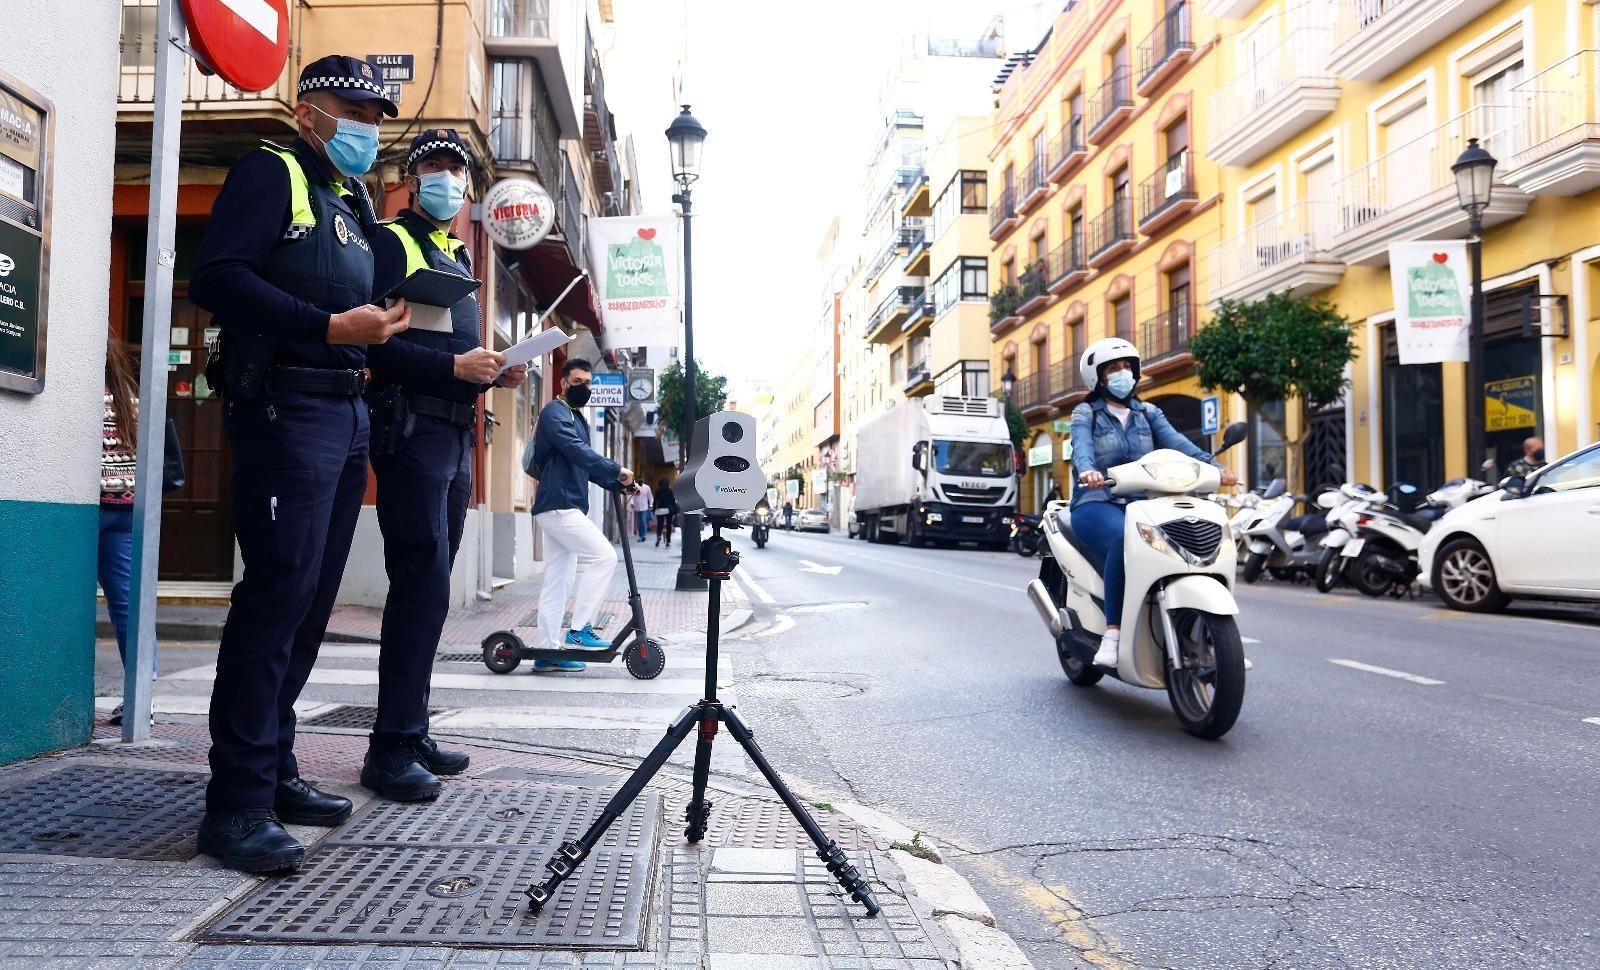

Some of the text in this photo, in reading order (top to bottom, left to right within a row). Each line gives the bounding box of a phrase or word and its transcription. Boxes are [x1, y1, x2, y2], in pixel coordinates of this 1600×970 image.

[376, 56, 402, 65] CALLE
[493, 203, 540, 220] VICTORIA
[590, 387, 622, 395] CLINICA
[590, 396, 621, 404] DENTAL
[1204, 400, 1215, 430] P
[961, 481, 987, 489] IVECO
[332, 904, 538, 920] EVILLANA
